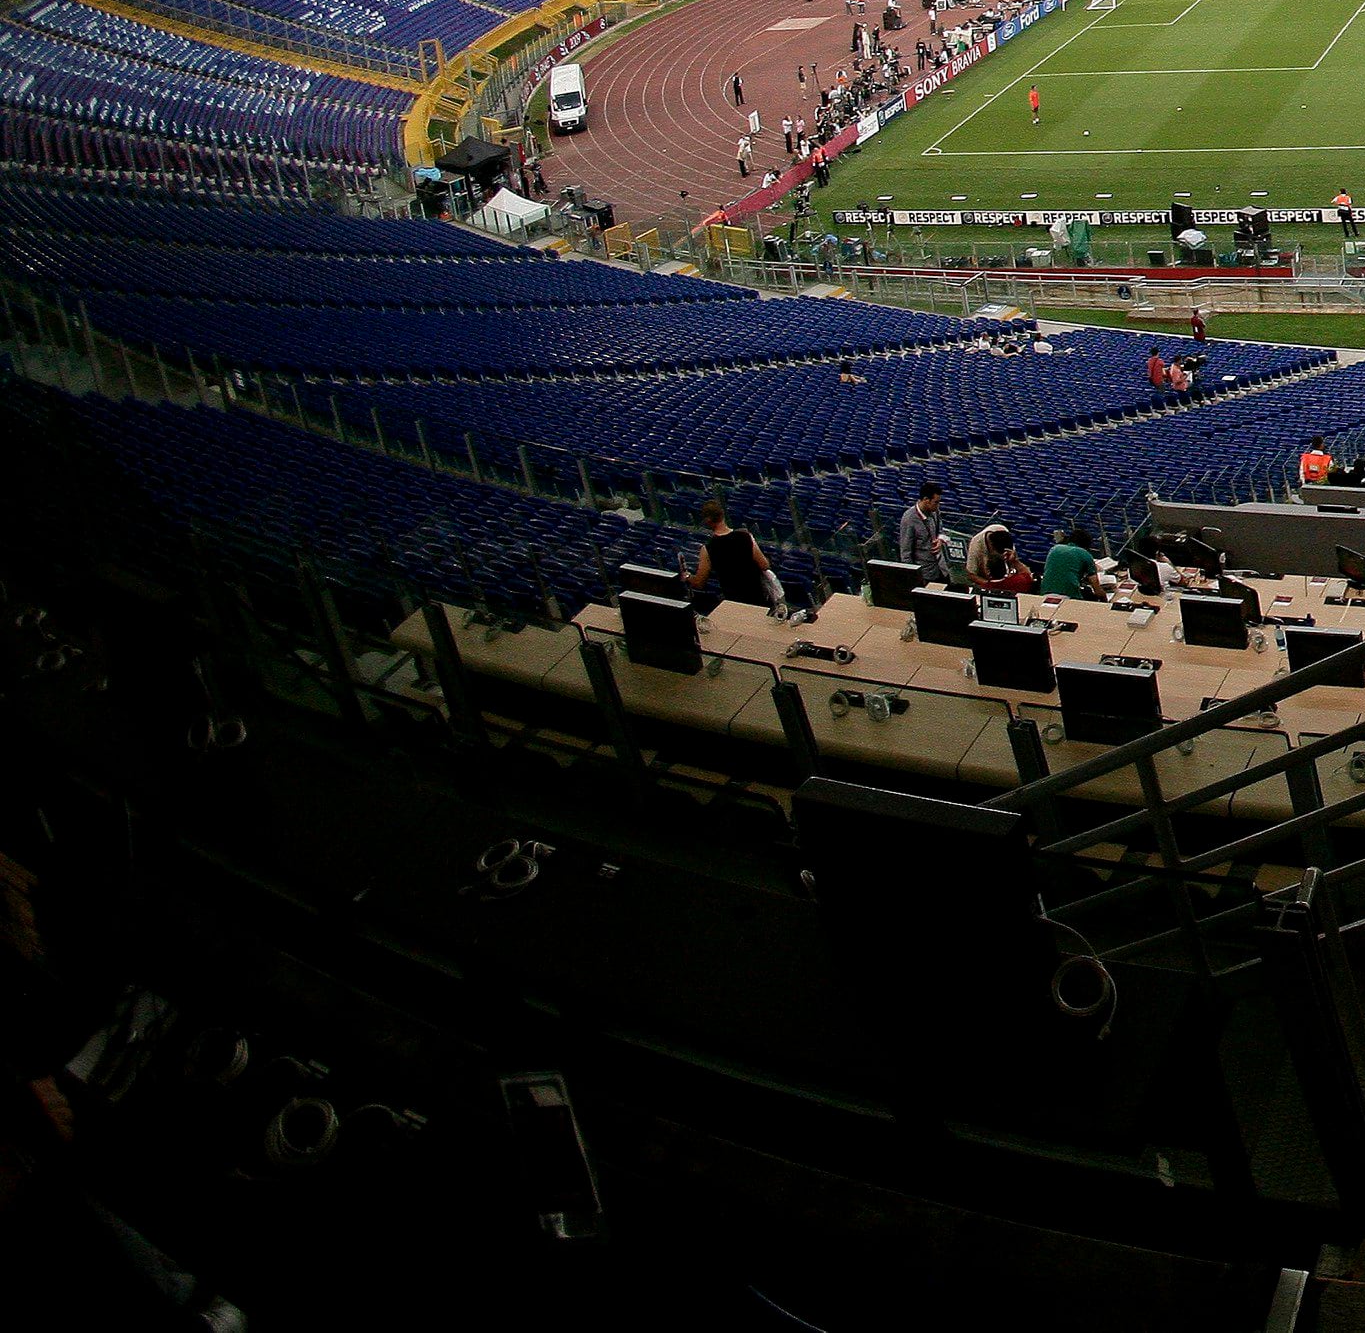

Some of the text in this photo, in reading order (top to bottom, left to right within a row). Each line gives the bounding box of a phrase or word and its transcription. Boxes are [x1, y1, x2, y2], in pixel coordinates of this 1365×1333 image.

[1020, 5, 1040, 30] Ford
[915, 45, 981, 101] SONY BRAVIA
[909, 213, 955, 223] RESPECT
[973, 213, 1023, 224] RESPECT
[1114, 212, 1167, 223] RESPECT
